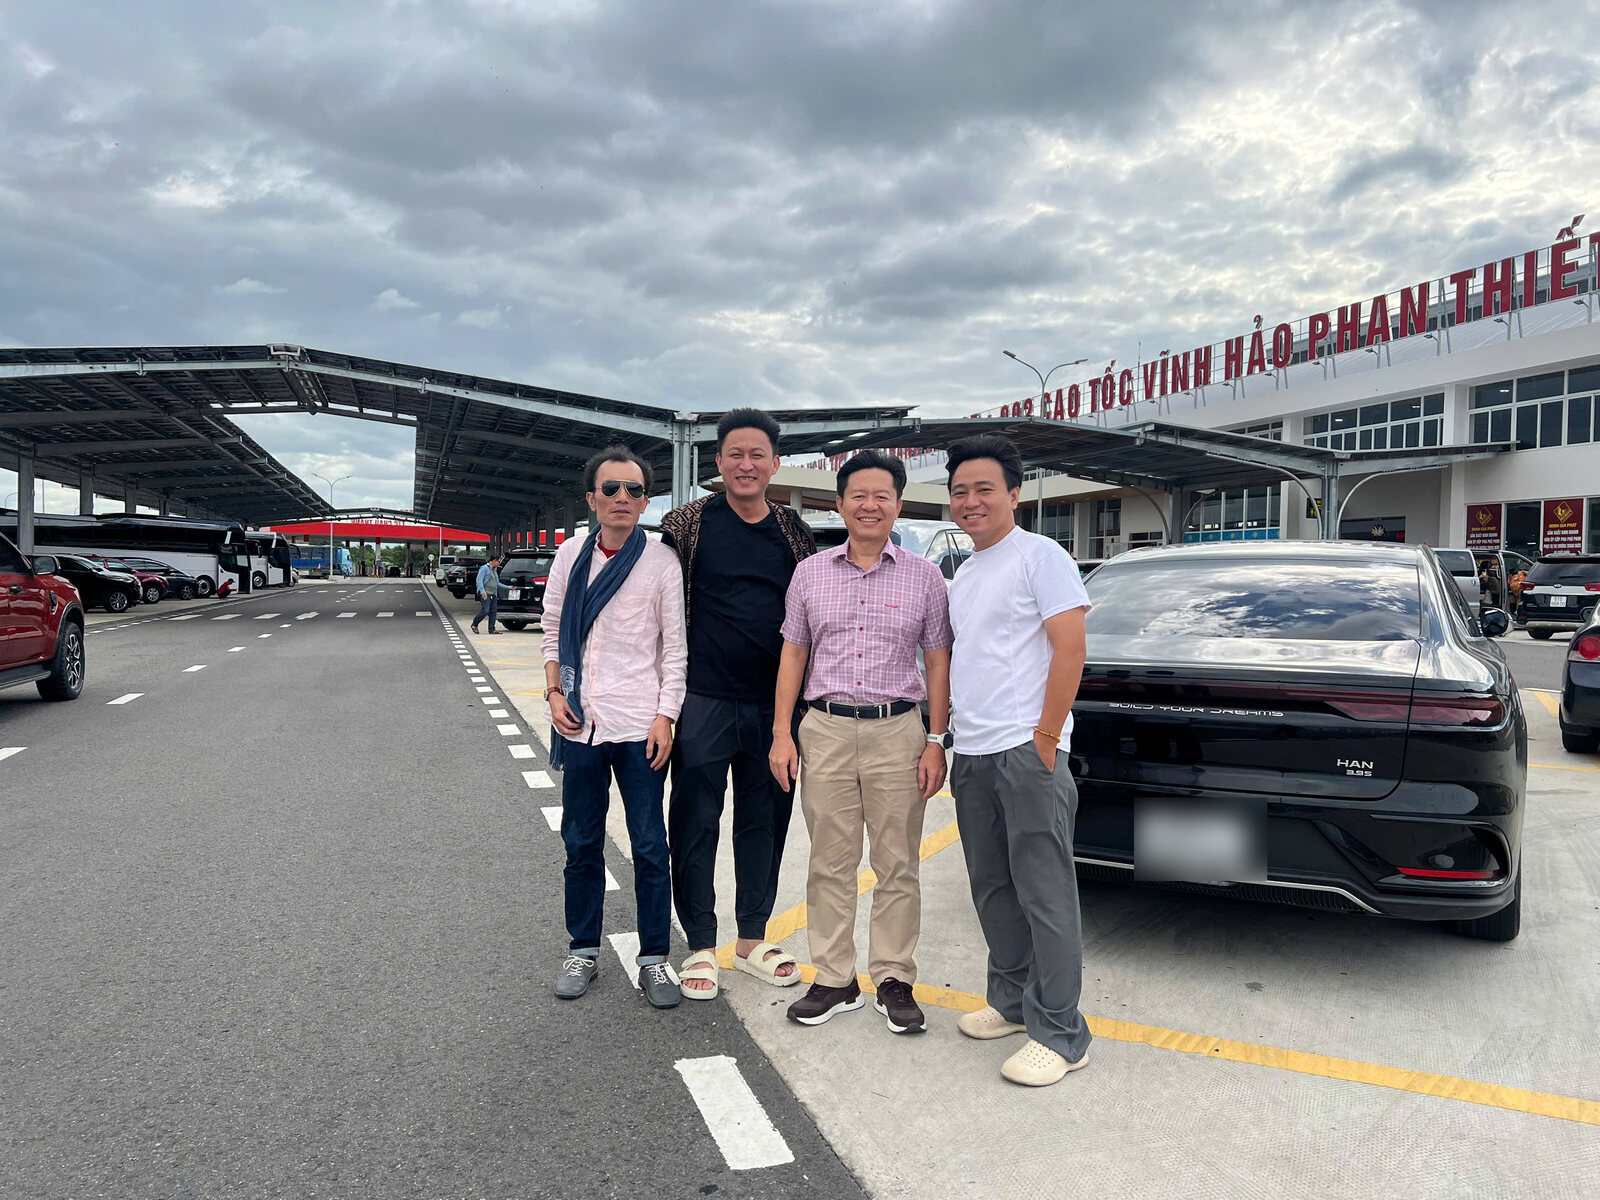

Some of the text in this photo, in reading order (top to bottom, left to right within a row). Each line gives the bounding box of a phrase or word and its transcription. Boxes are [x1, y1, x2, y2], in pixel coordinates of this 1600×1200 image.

[1042, 384, 1081, 420] CAO
[1089, 360, 1133, 412] TỐC
[1143, 349, 1212, 400] VĨNH
[1225, 314, 1293, 381] HẢO
[1308, 281, 1430, 361] PHAN
[1109, 702, 1284, 717] BUILD YOUR DREAMS
[1337, 758, 1374, 769] HAN
